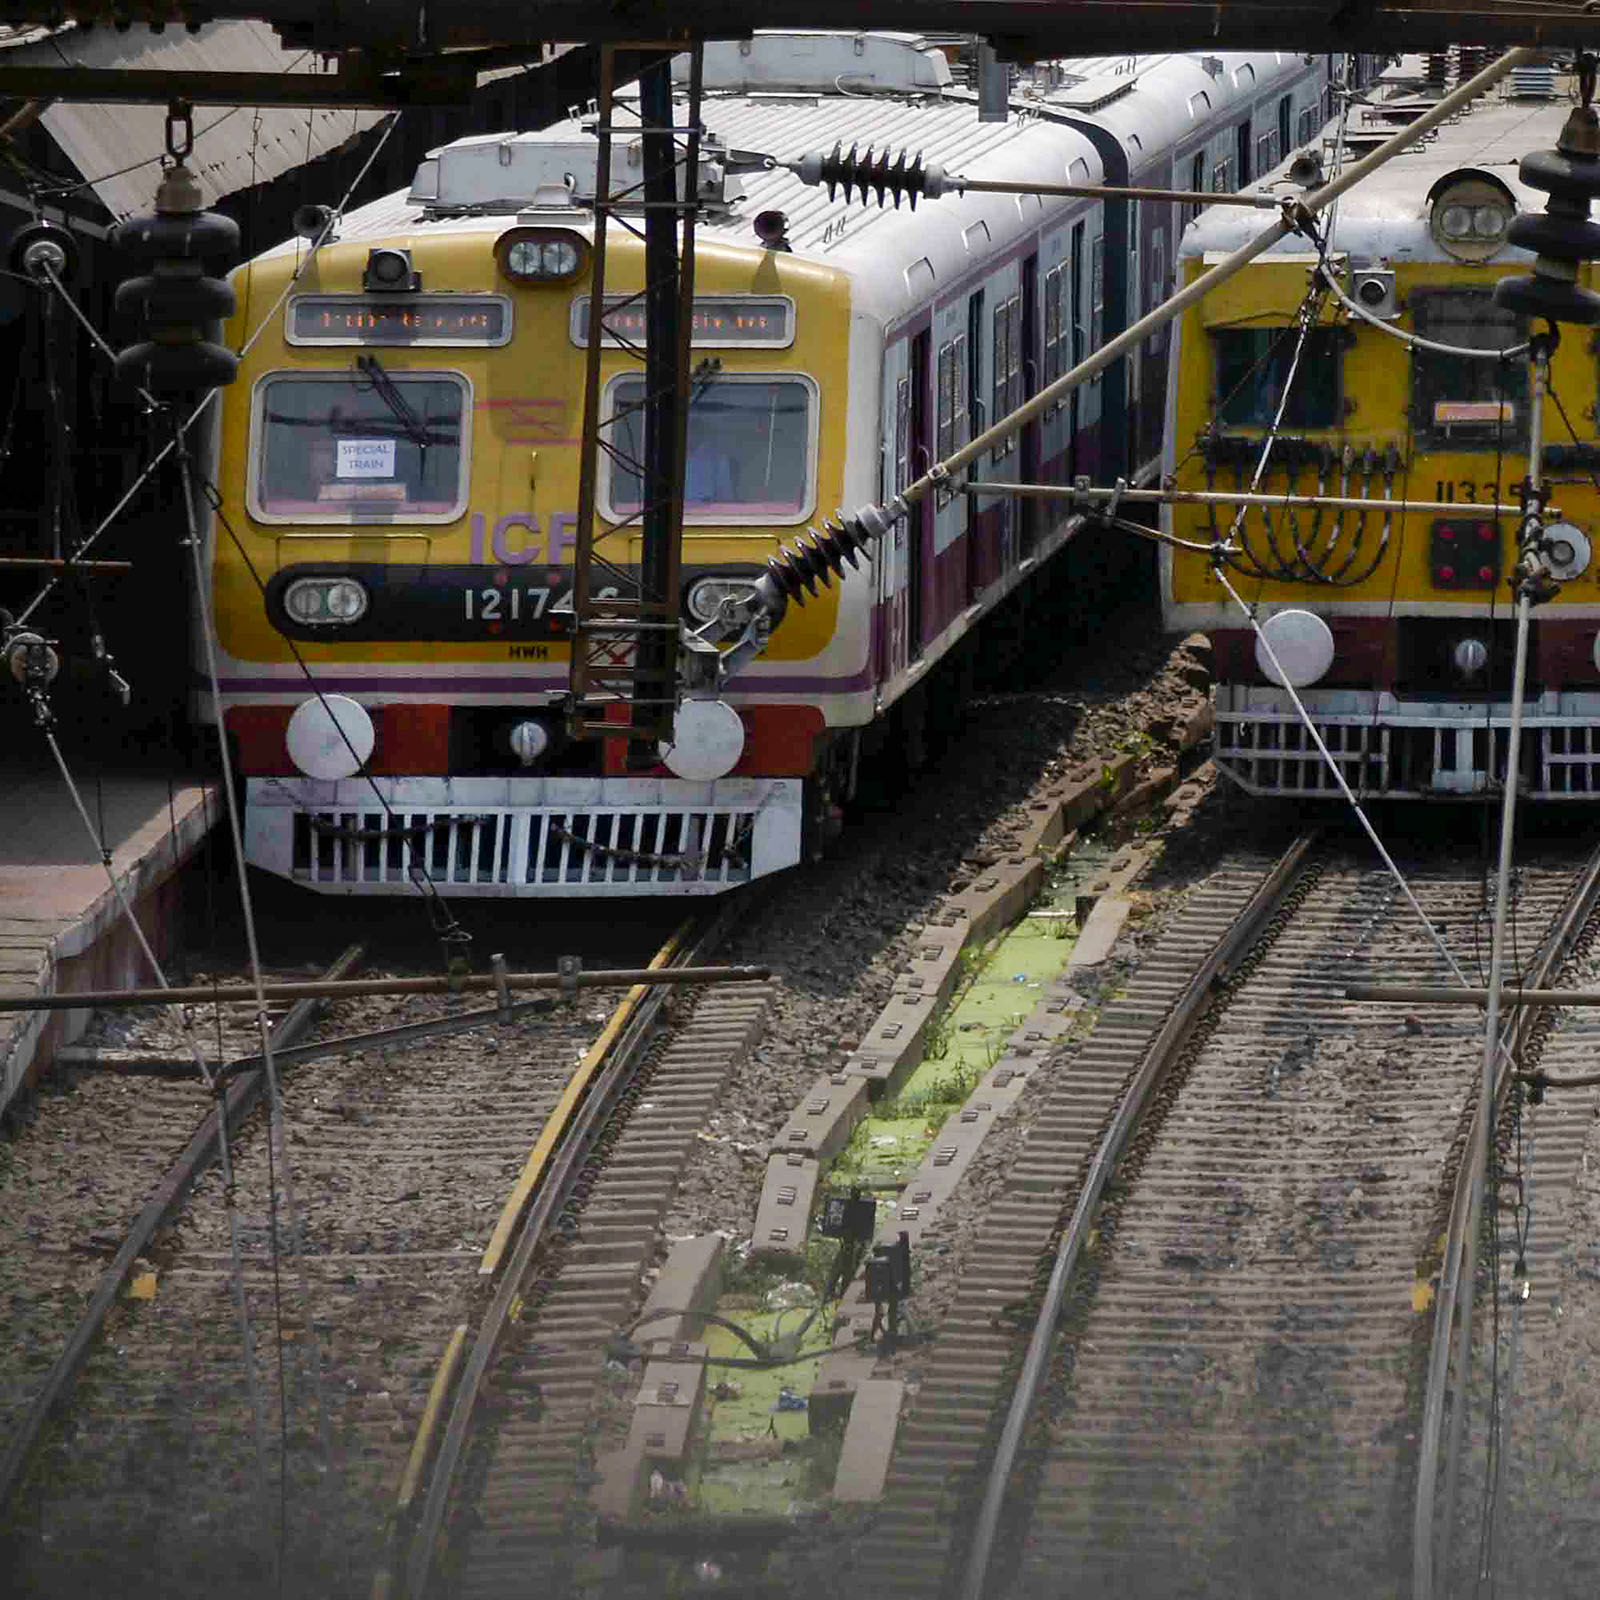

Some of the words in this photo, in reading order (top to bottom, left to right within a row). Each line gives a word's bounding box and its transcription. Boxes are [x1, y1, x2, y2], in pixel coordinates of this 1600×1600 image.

[342, 444, 391, 456] SPECIAL
[349, 460, 385, 470] TRAIN
[469, 511, 578, 565] ICF
